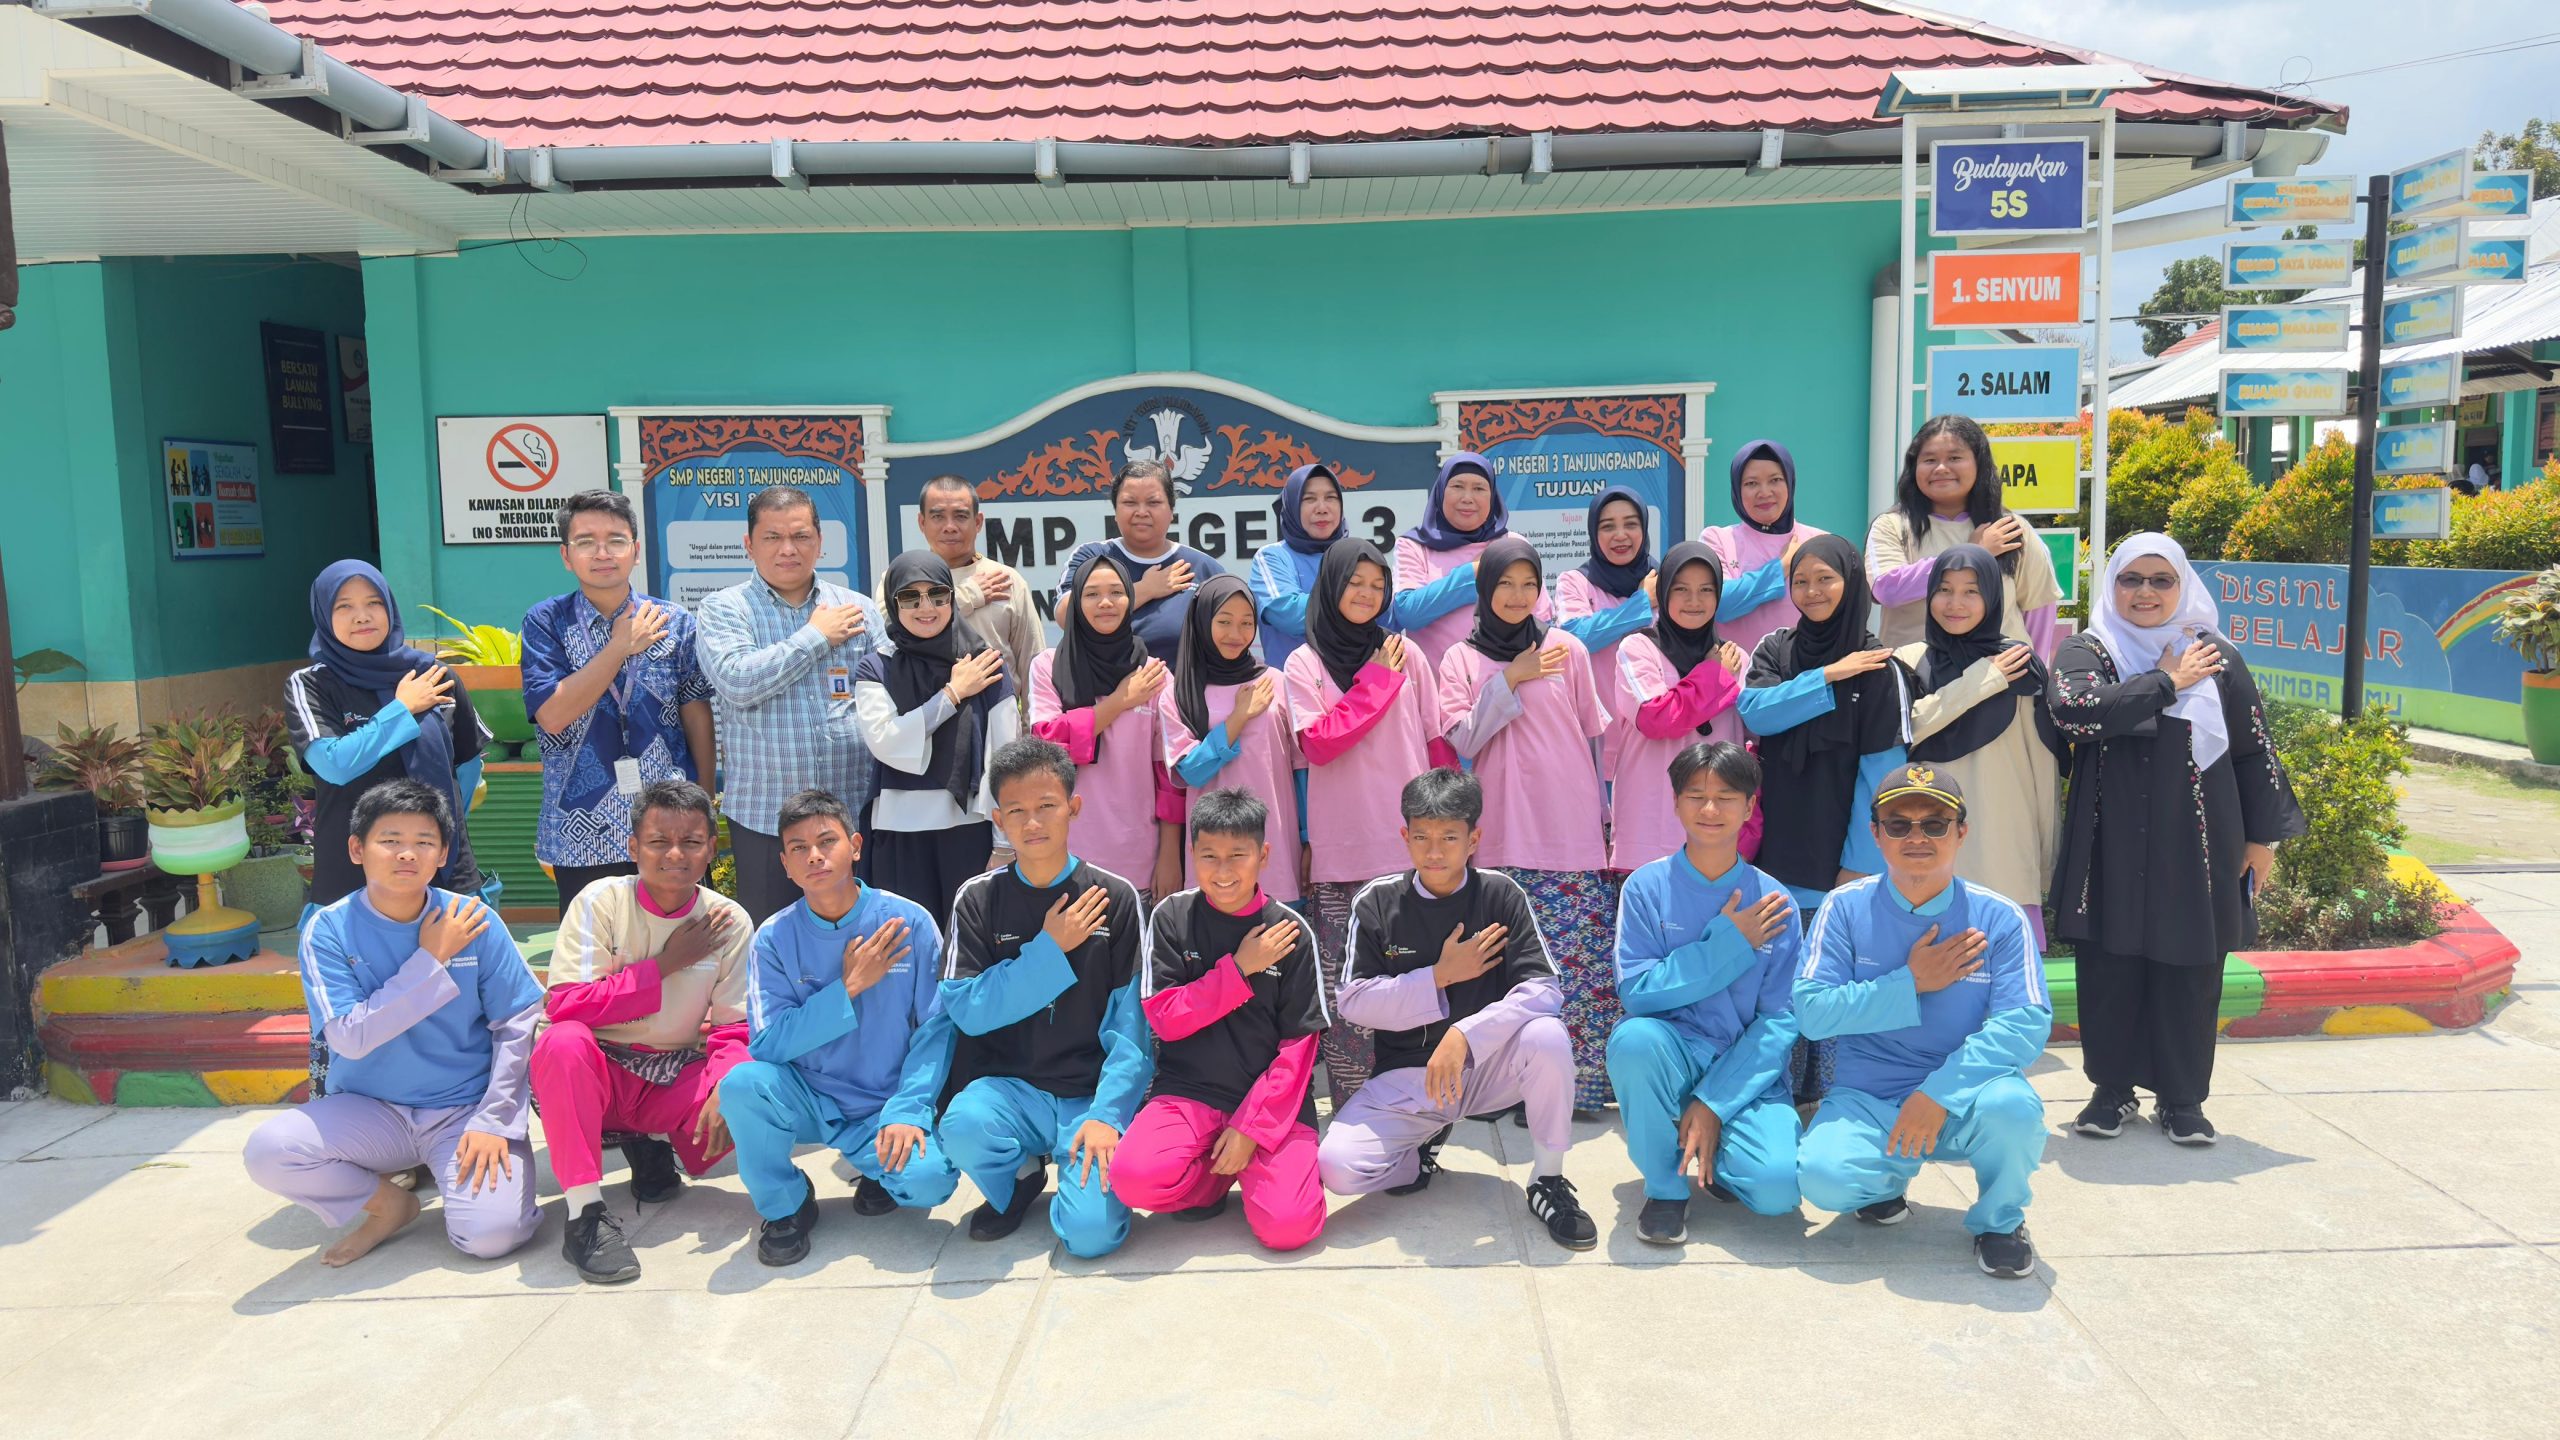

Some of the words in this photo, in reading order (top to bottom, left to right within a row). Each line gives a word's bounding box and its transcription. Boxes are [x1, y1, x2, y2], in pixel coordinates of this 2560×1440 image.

[1952, 153, 2068, 192] Budayakan
[1990, 189, 2029, 219] 5S
[2467, 253, 2509, 269] HASA
[1952, 278, 1971, 303] 1.
[1976, 276, 2061, 302] SENYUM
[1957, 372, 1975, 396] 2.
[1981, 371, 2050, 396] SALAM
[282, 395, 323, 412] BULLYING
[1508, 454, 1549, 475] NEGERI
[1552, 452, 1559, 473] 3
[1562, 450, 1660, 473] TANJUNGPANDAN
[669, 468, 694, 485] SMP
[696, 467, 736, 485] NEGERI
[738, 467, 745, 485] 3
[748, 467, 841, 486] TANJUNGPANDAN
[2001, 464, 2038, 487] APA
[702, 492, 740, 507] VISI
[1534, 480, 1607, 498] TUJUAN
[469, 499, 525, 511] KAWASAN
[527, 498, 570, 510] DILARA
[499, 512, 555, 525] MEROKOK
[1562, 513, 1583, 525] Tujuan
[472, 527, 493, 539] (NO
[495, 526, 548, 539] SMOKING
[985, 516, 1077, 567] MP
[1362, 506, 1396, 554] 3
[2229, 614, 2403, 668] BELAJR
[2251, 671, 2331, 705] NIMBA
